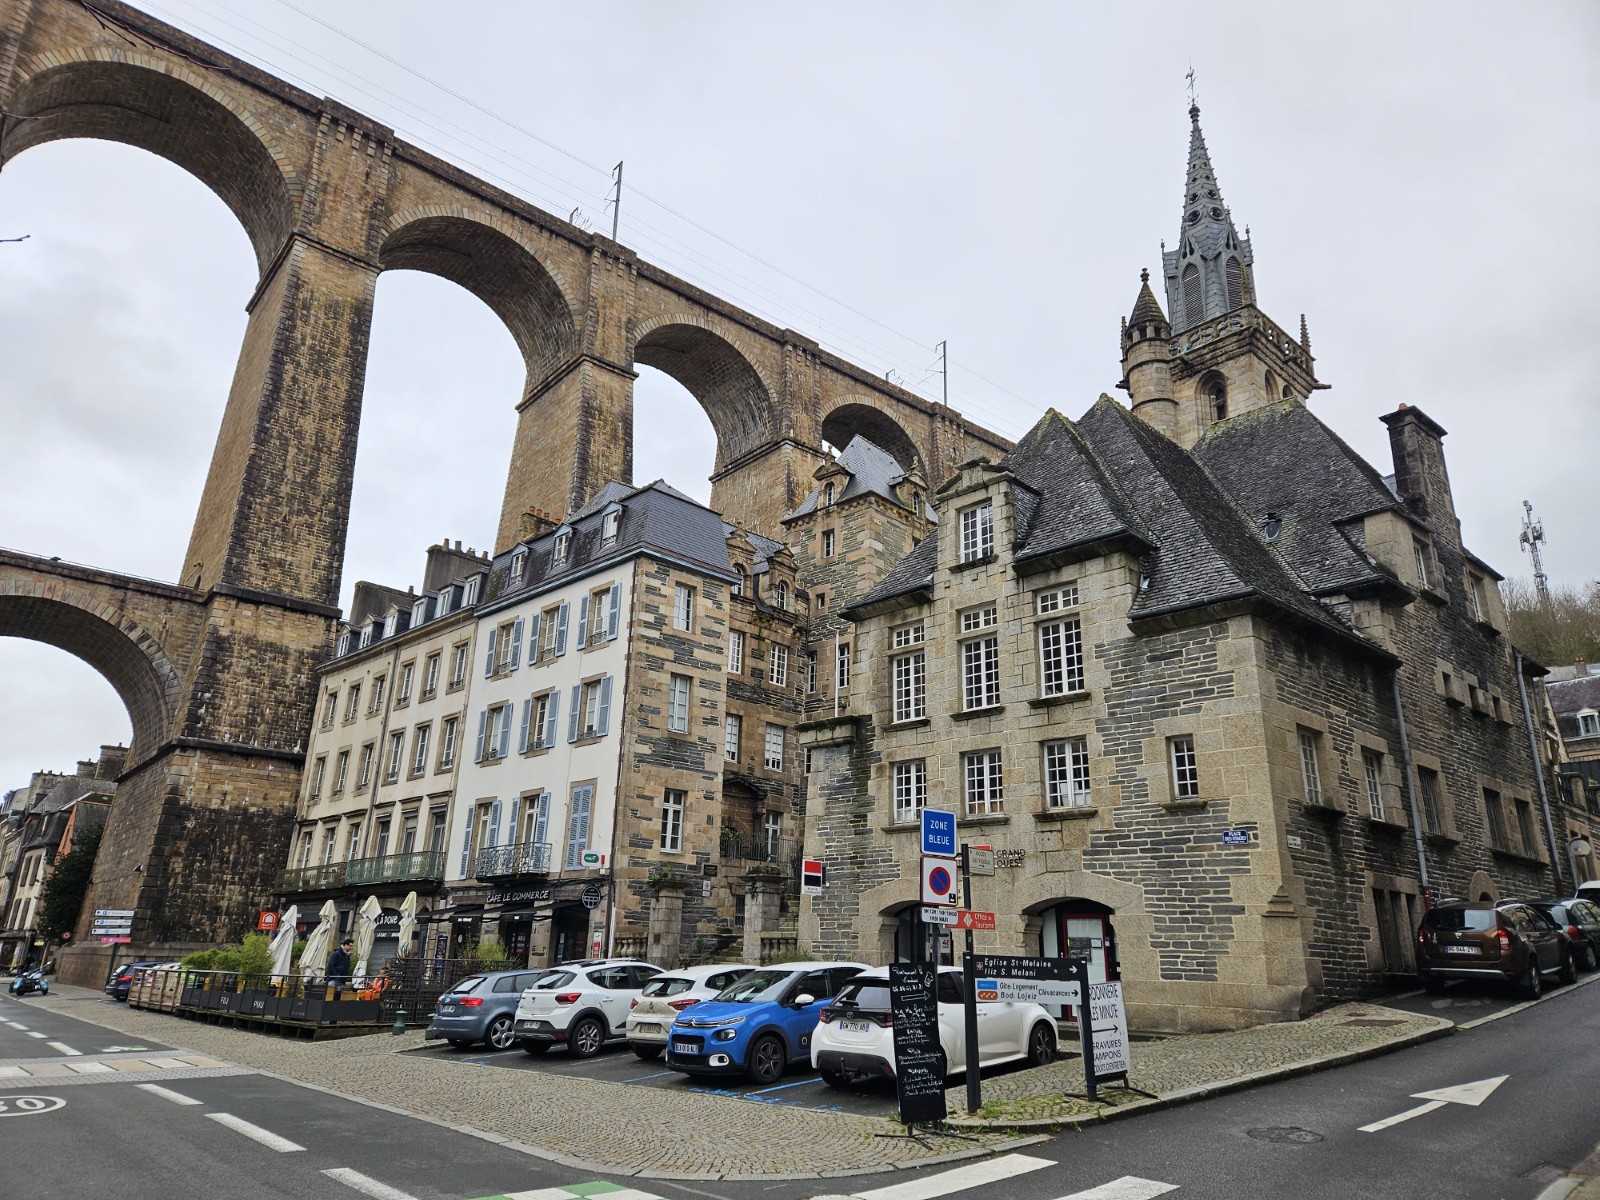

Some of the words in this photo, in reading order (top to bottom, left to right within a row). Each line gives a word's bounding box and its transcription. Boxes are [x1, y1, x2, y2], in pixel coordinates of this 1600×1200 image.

[930, 820, 948, 830] ZONE
[928, 834, 950, 845] BLEUE
[996, 848, 1026, 858] GRAND
[996, 858, 1024, 867] OUEST
[502, 893, 511, 901] LE
[512, 890, 550, 900] COMMERCE
[974, 912, 987, 920] Office
[975, 921, 994, 929] Tourisme
[984, 957, 1007, 967] Eglise
[1089, 983, 1118, 1001] RDONNERIE
